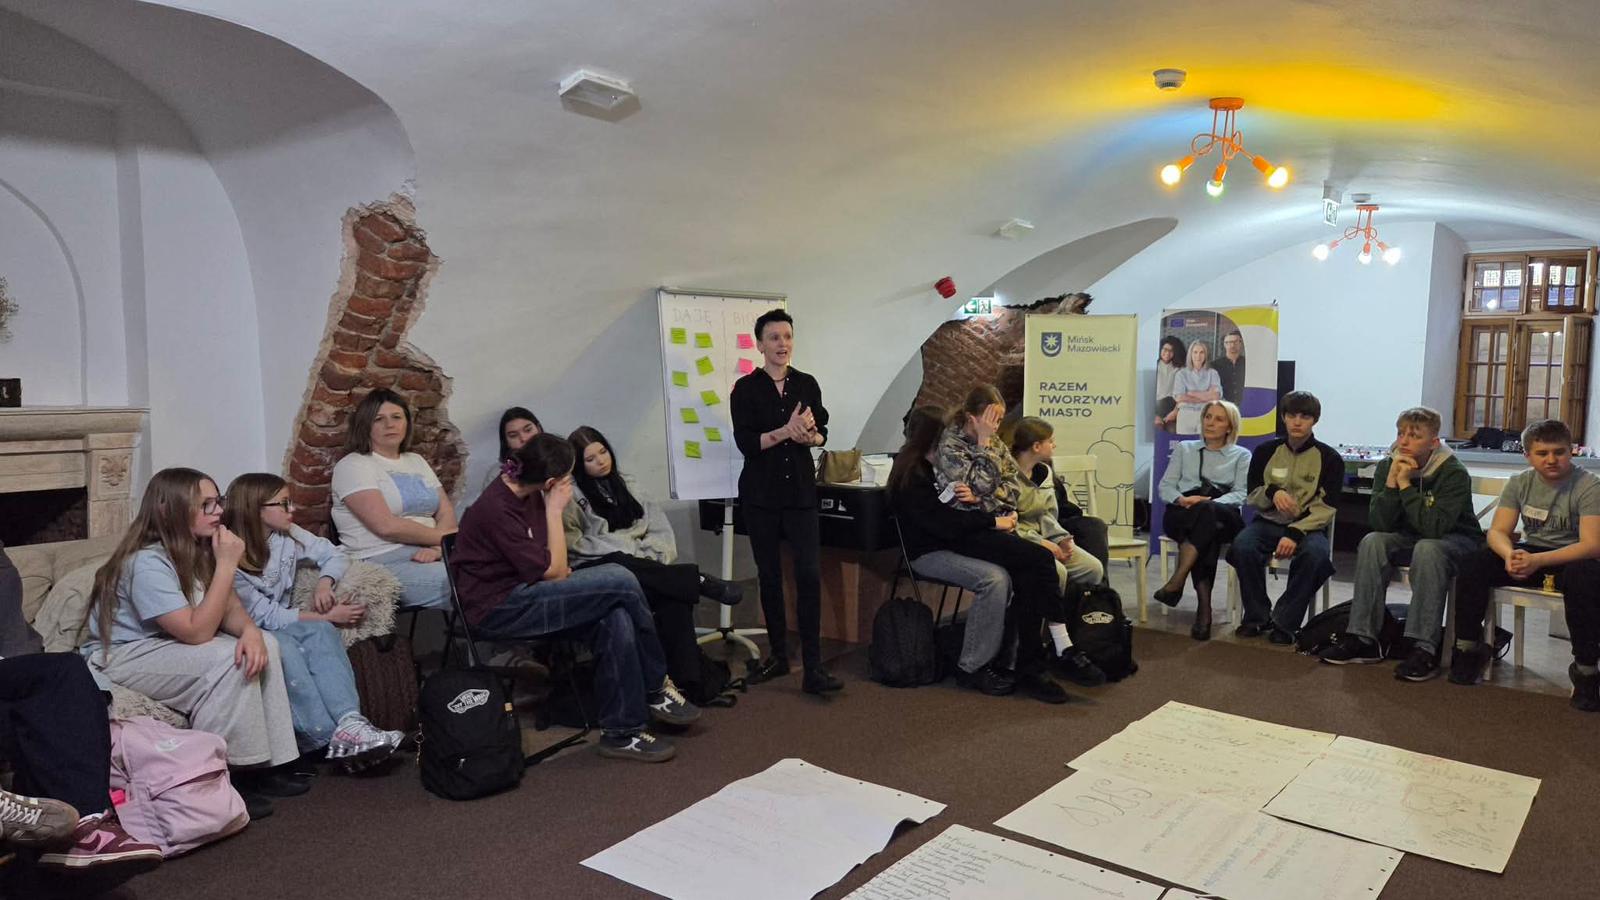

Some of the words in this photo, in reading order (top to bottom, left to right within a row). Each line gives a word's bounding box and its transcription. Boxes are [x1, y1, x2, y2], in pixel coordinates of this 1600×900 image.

[1067, 335, 1094, 344] Mińsk
[1067, 344, 1121, 353] Mazowiecki
[1039, 382, 1088, 391] RAZEM
[1039, 394, 1122, 405] TWORZYMY
[1039, 408, 1093, 417] MIASTO
